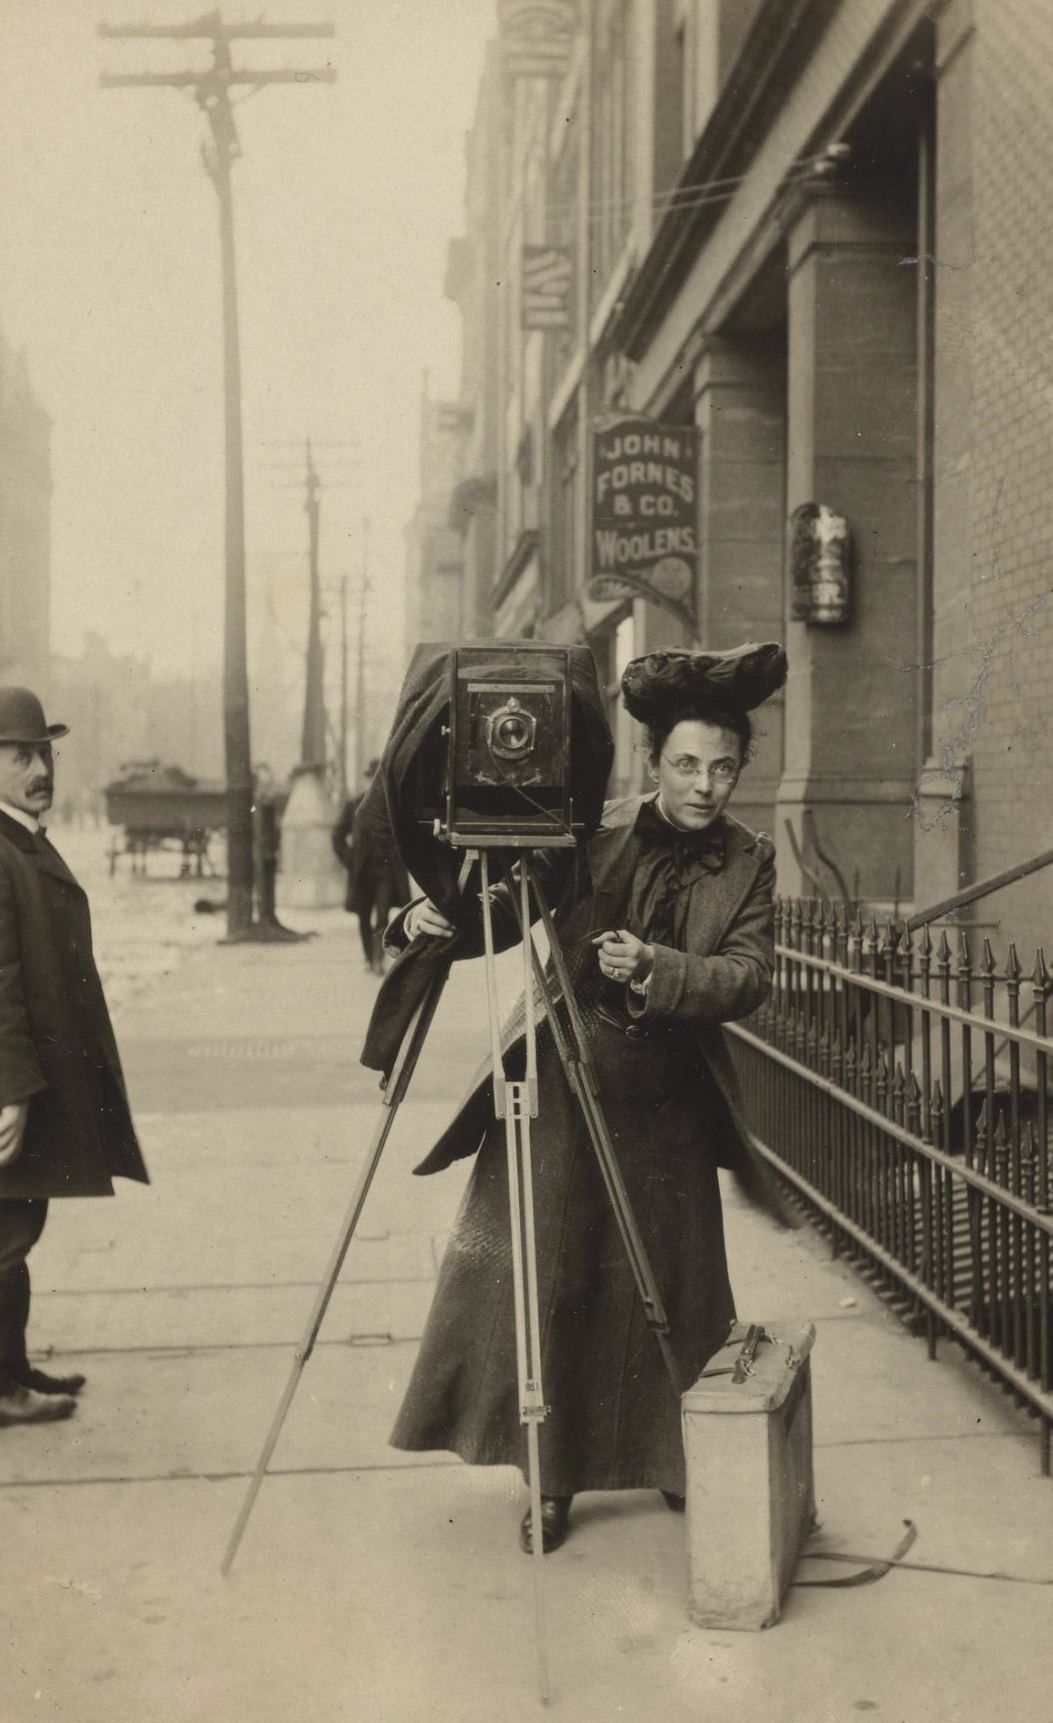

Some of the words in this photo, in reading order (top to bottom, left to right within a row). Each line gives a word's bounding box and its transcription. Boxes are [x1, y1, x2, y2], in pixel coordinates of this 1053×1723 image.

[606, 434, 680, 460] JOHN
[597, 461, 694, 503] FORNES
[613, 494, 632, 516] &
[639, 494, 679, 517] CO.
[596, 526, 694, 568] WOOLENS
